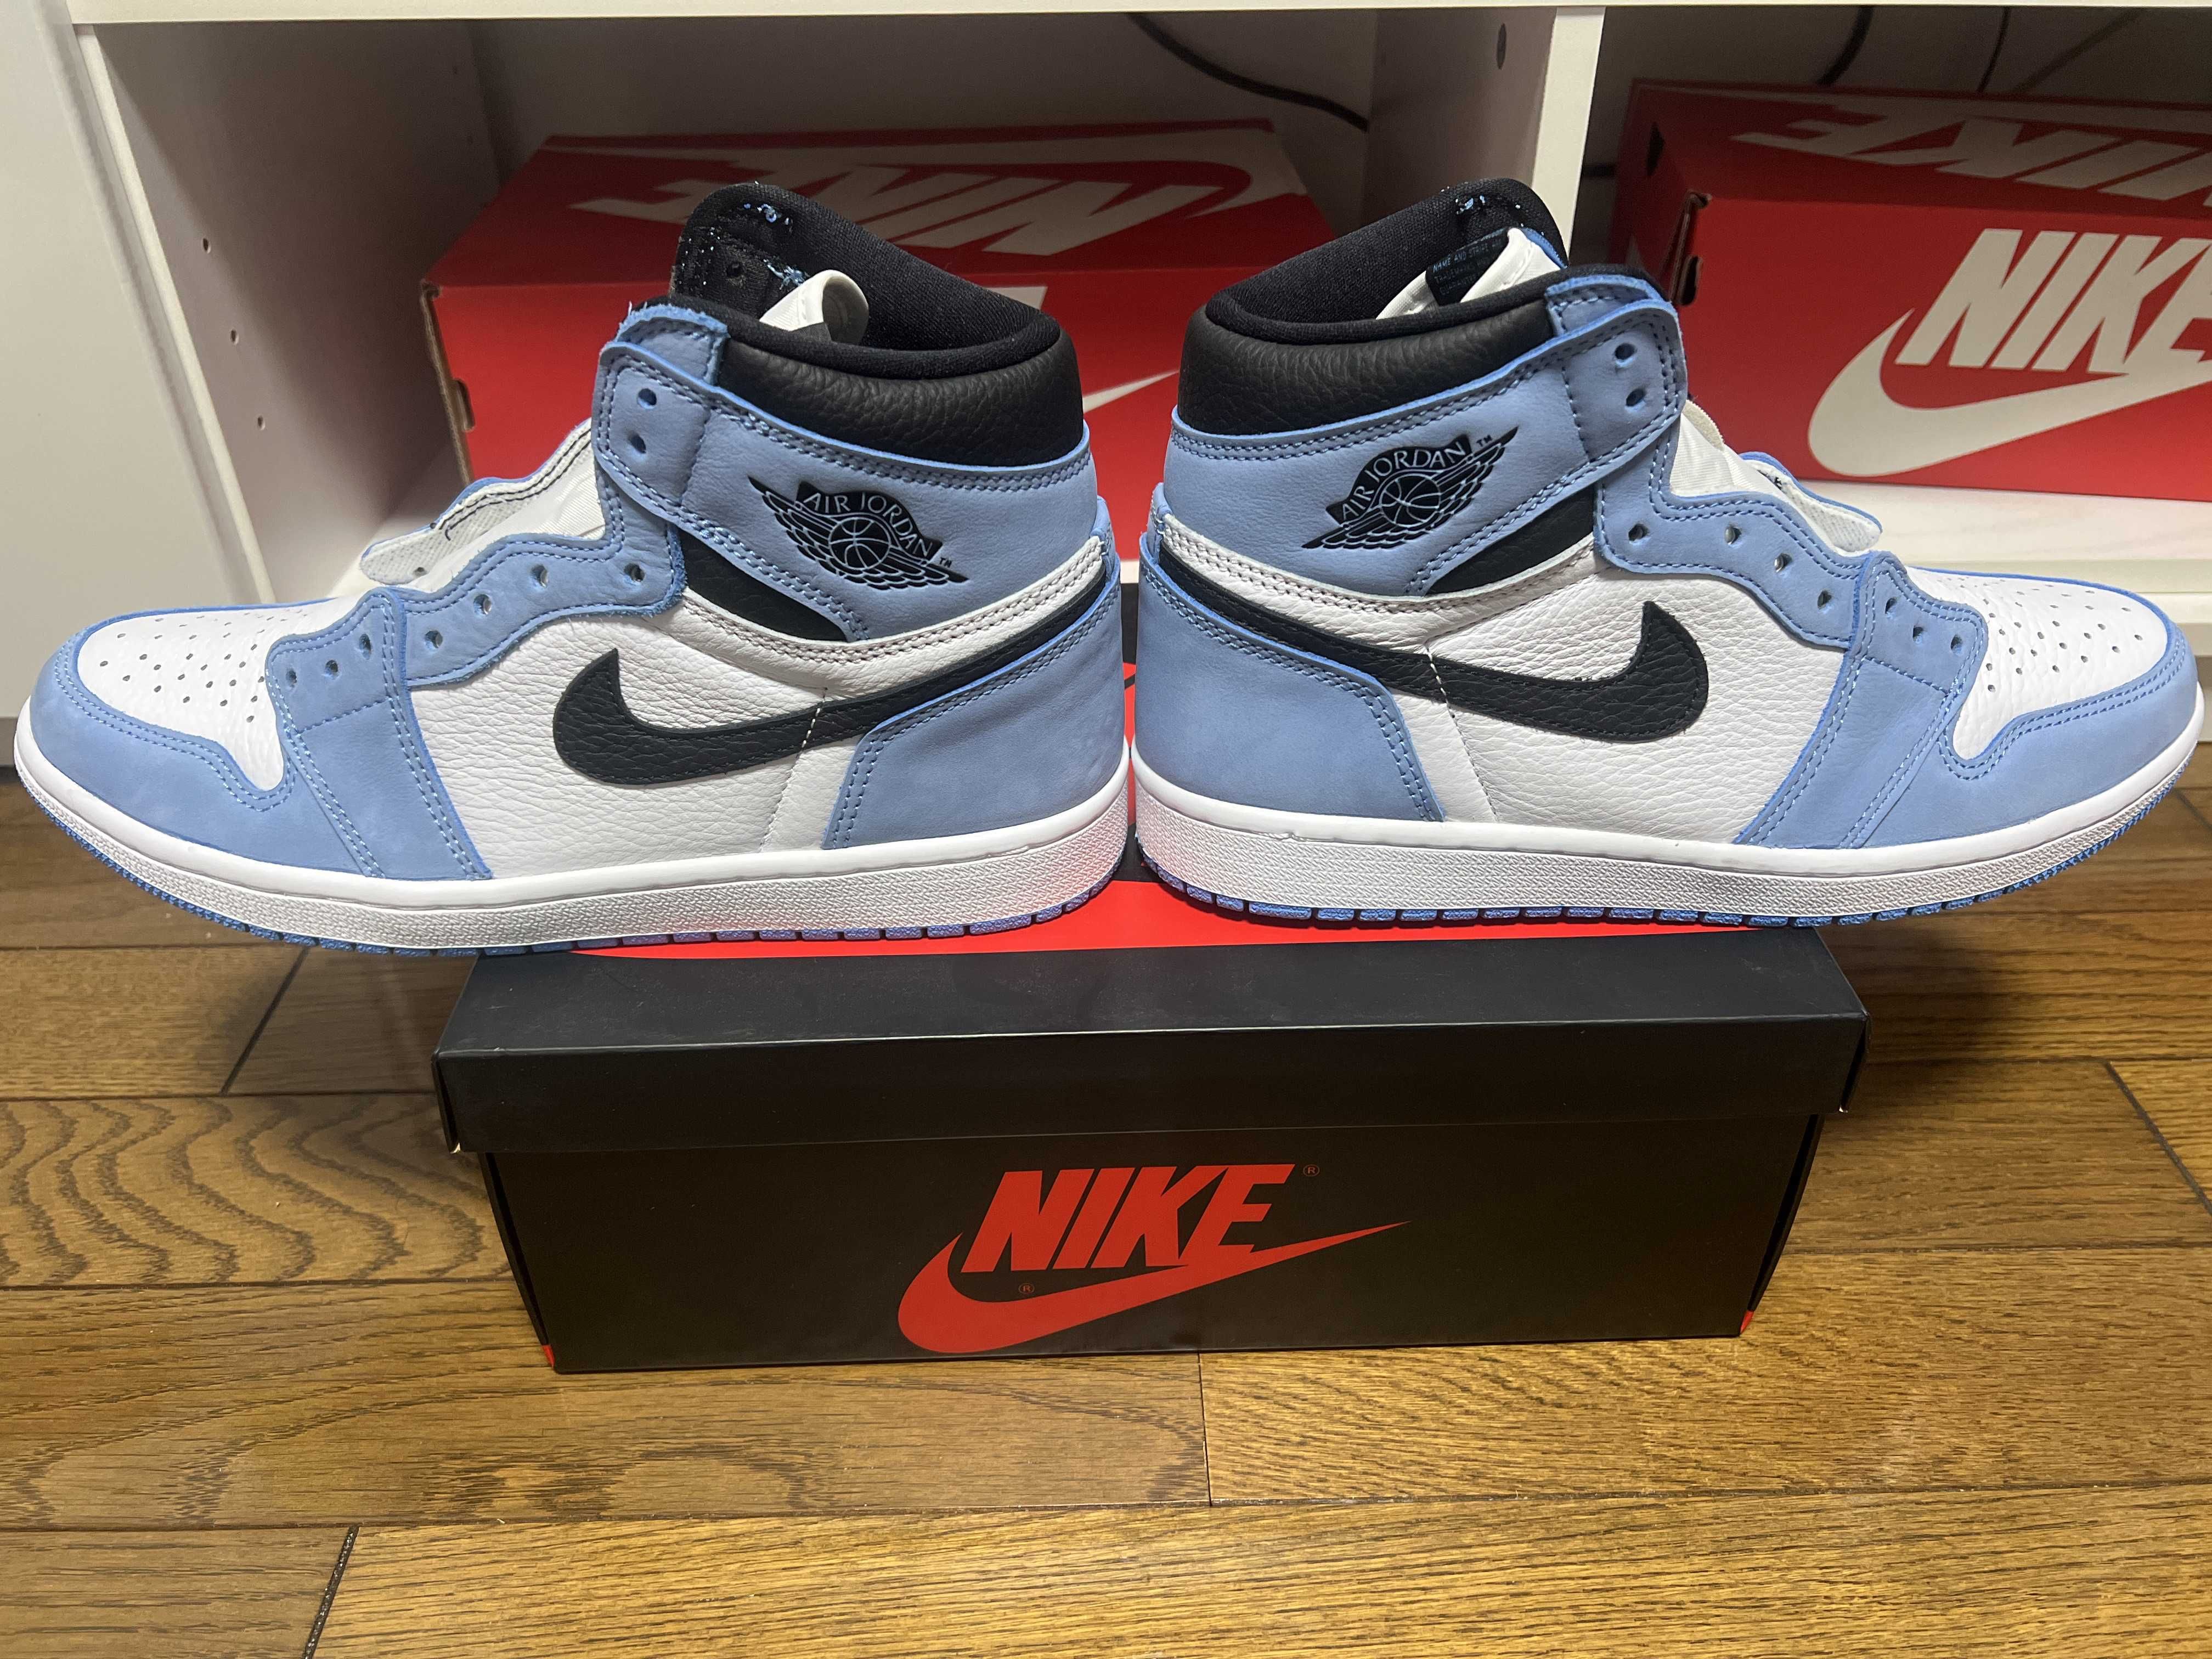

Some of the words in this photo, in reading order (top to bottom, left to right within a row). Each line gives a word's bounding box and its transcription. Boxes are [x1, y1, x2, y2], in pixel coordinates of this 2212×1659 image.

[1342, 486, 1374, 520] AIR
[1366, 442, 1466, 483] JORDAN
[803, 493, 850, 514] AIR
[861, 492, 933, 558] JORDAN
[961, 1164, 1295, 1272] NIKE
